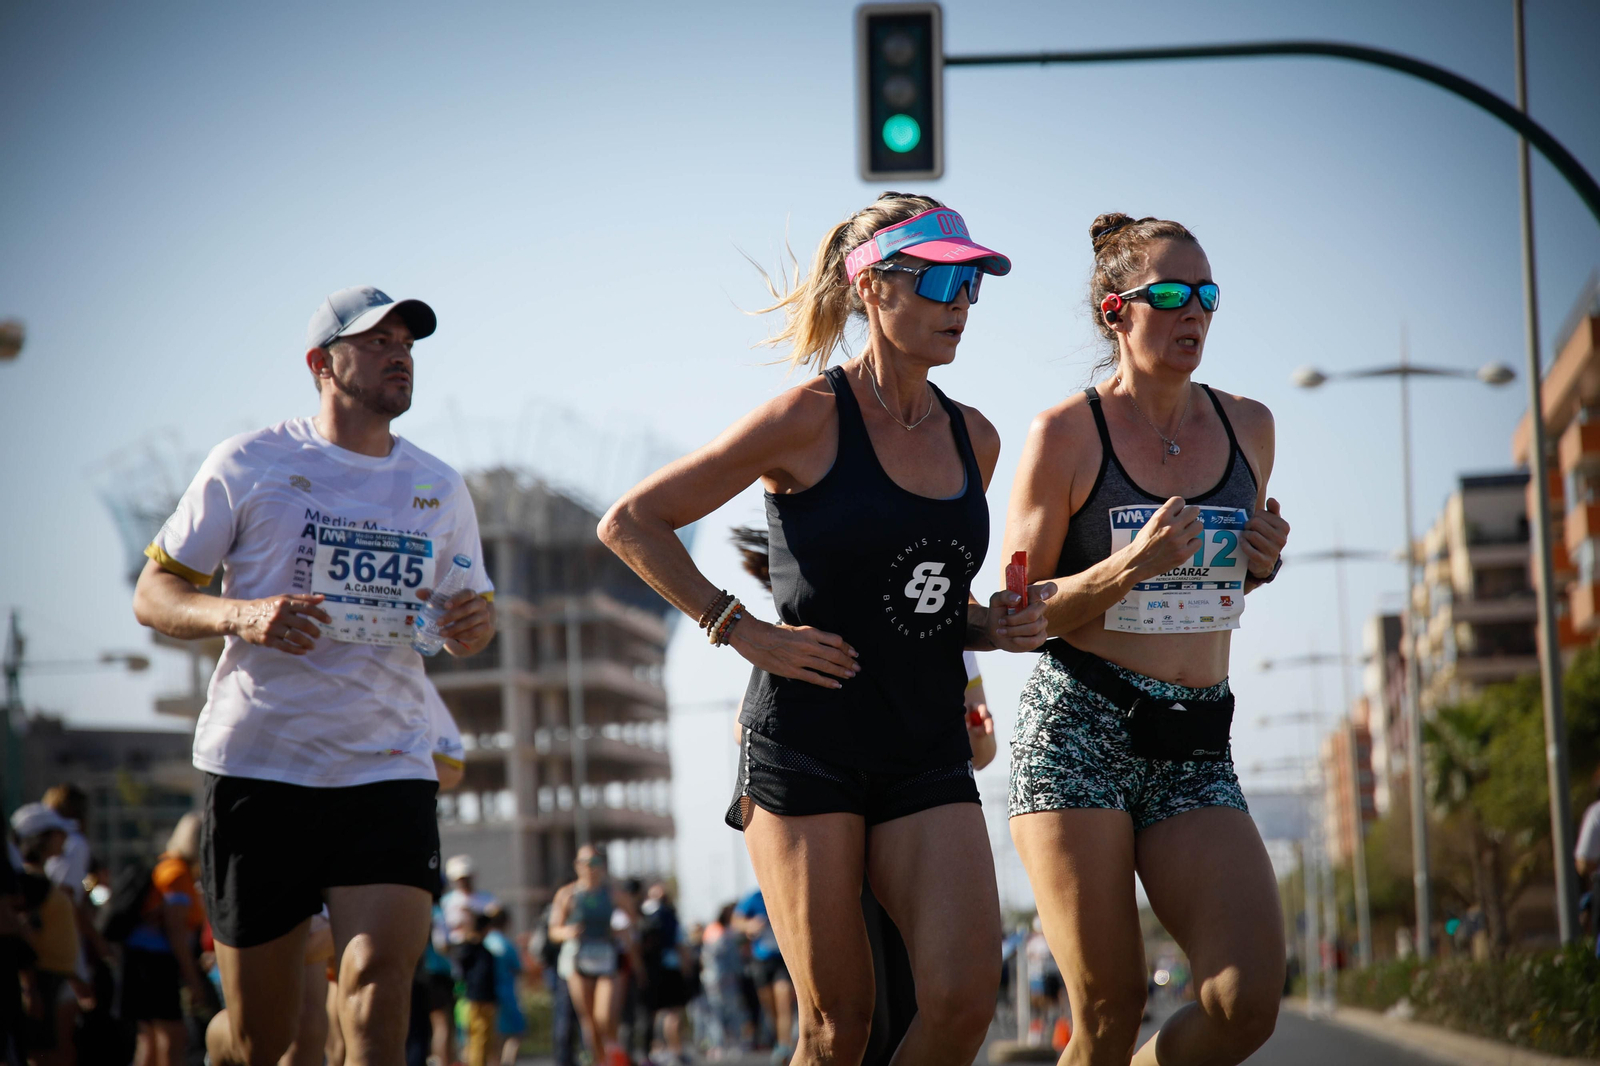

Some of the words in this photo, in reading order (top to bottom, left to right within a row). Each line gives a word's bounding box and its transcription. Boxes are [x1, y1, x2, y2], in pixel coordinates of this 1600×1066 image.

[328, 547, 424, 588] 5645
[891, 538, 927, 568] TENIS
[951, 539, 974, 575] PADEL
[344, 583, 402, 597] A.CARMONA
